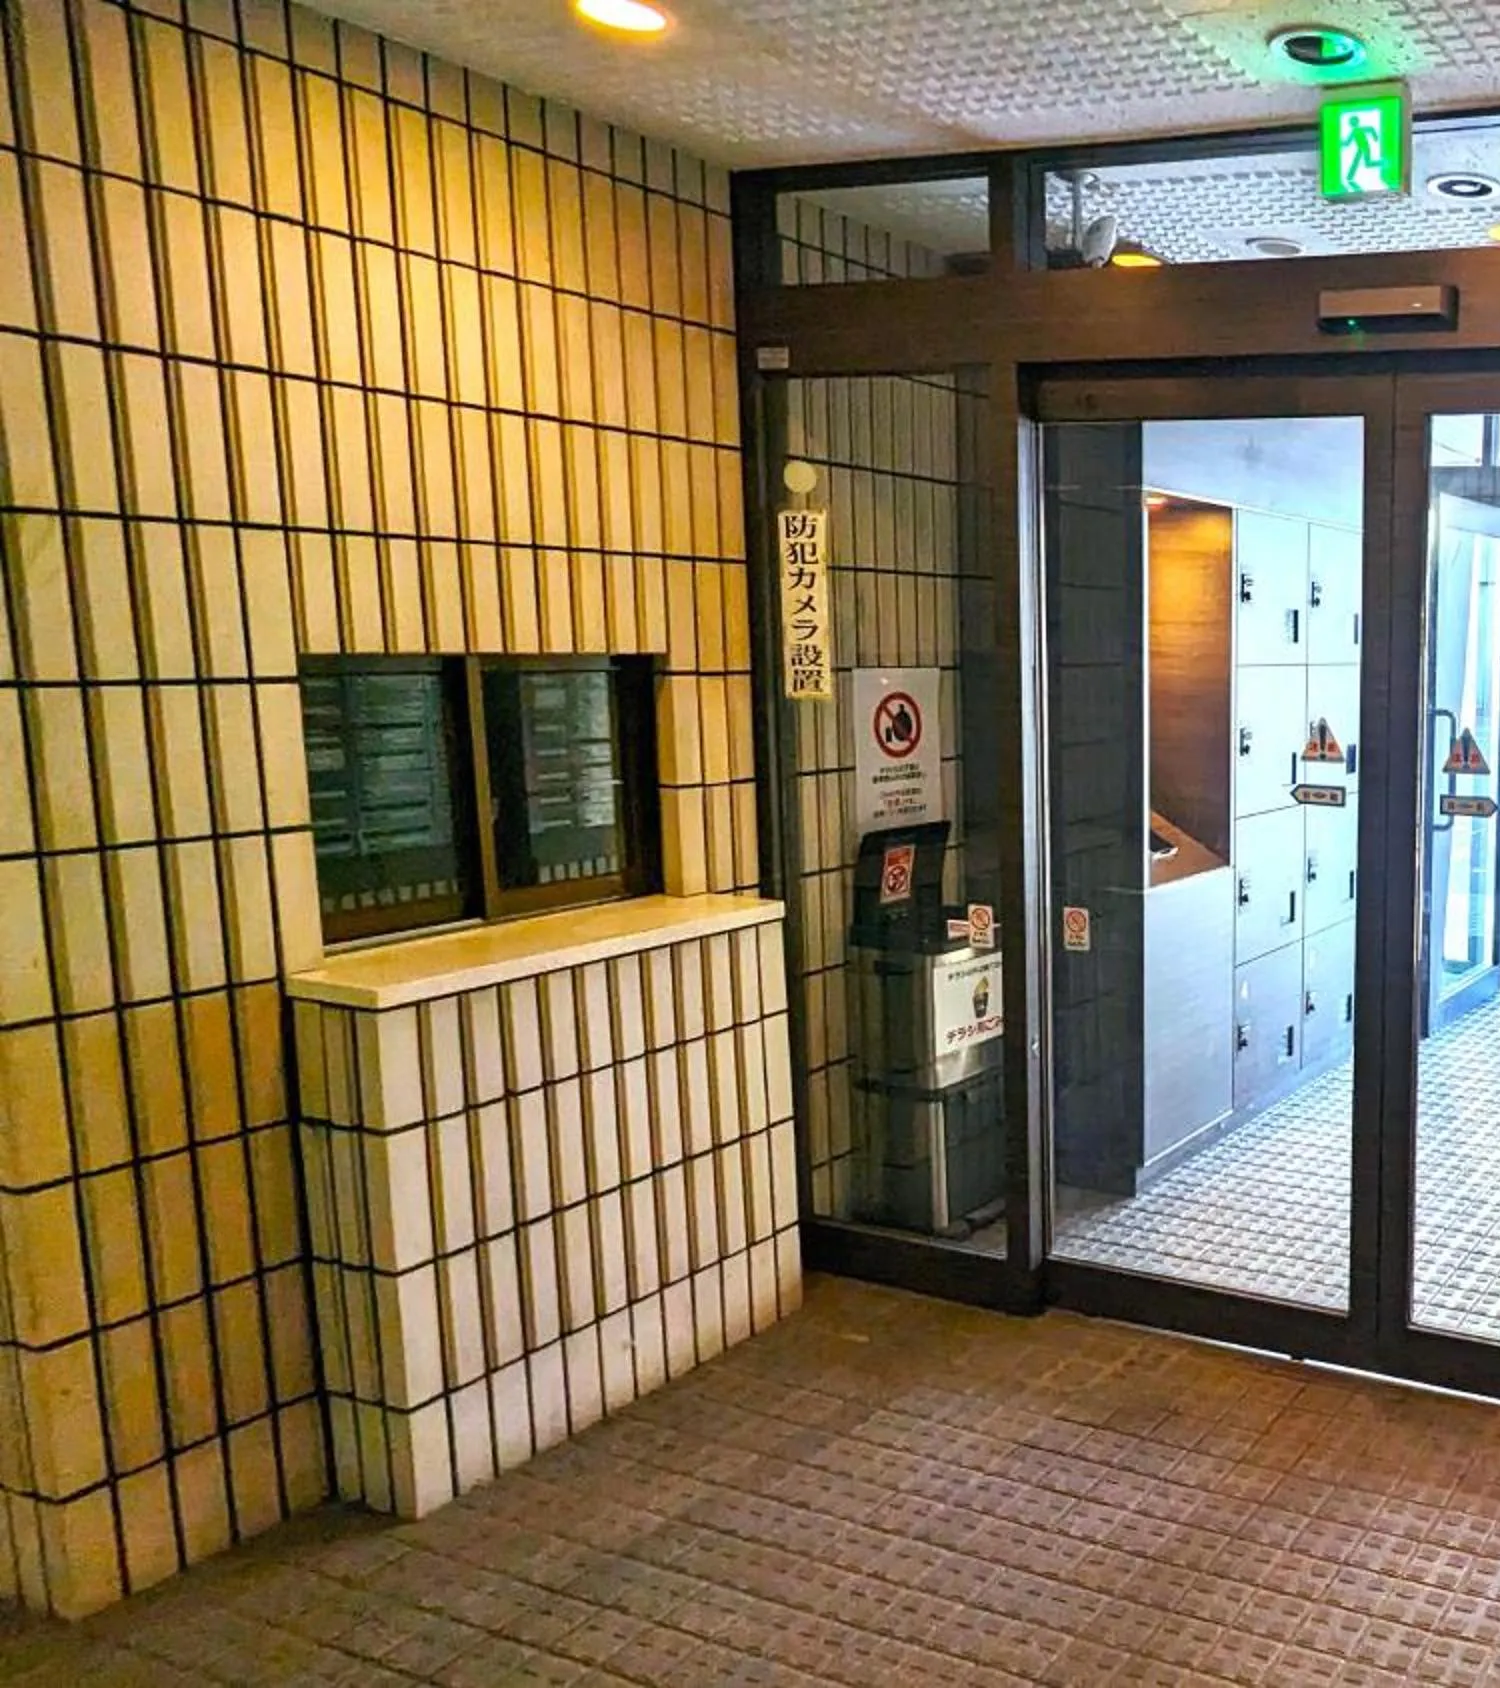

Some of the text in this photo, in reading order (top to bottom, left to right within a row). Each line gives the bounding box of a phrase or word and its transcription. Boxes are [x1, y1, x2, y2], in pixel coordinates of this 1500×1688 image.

[785, 515, 824, 692] 防犯カメラ設置
